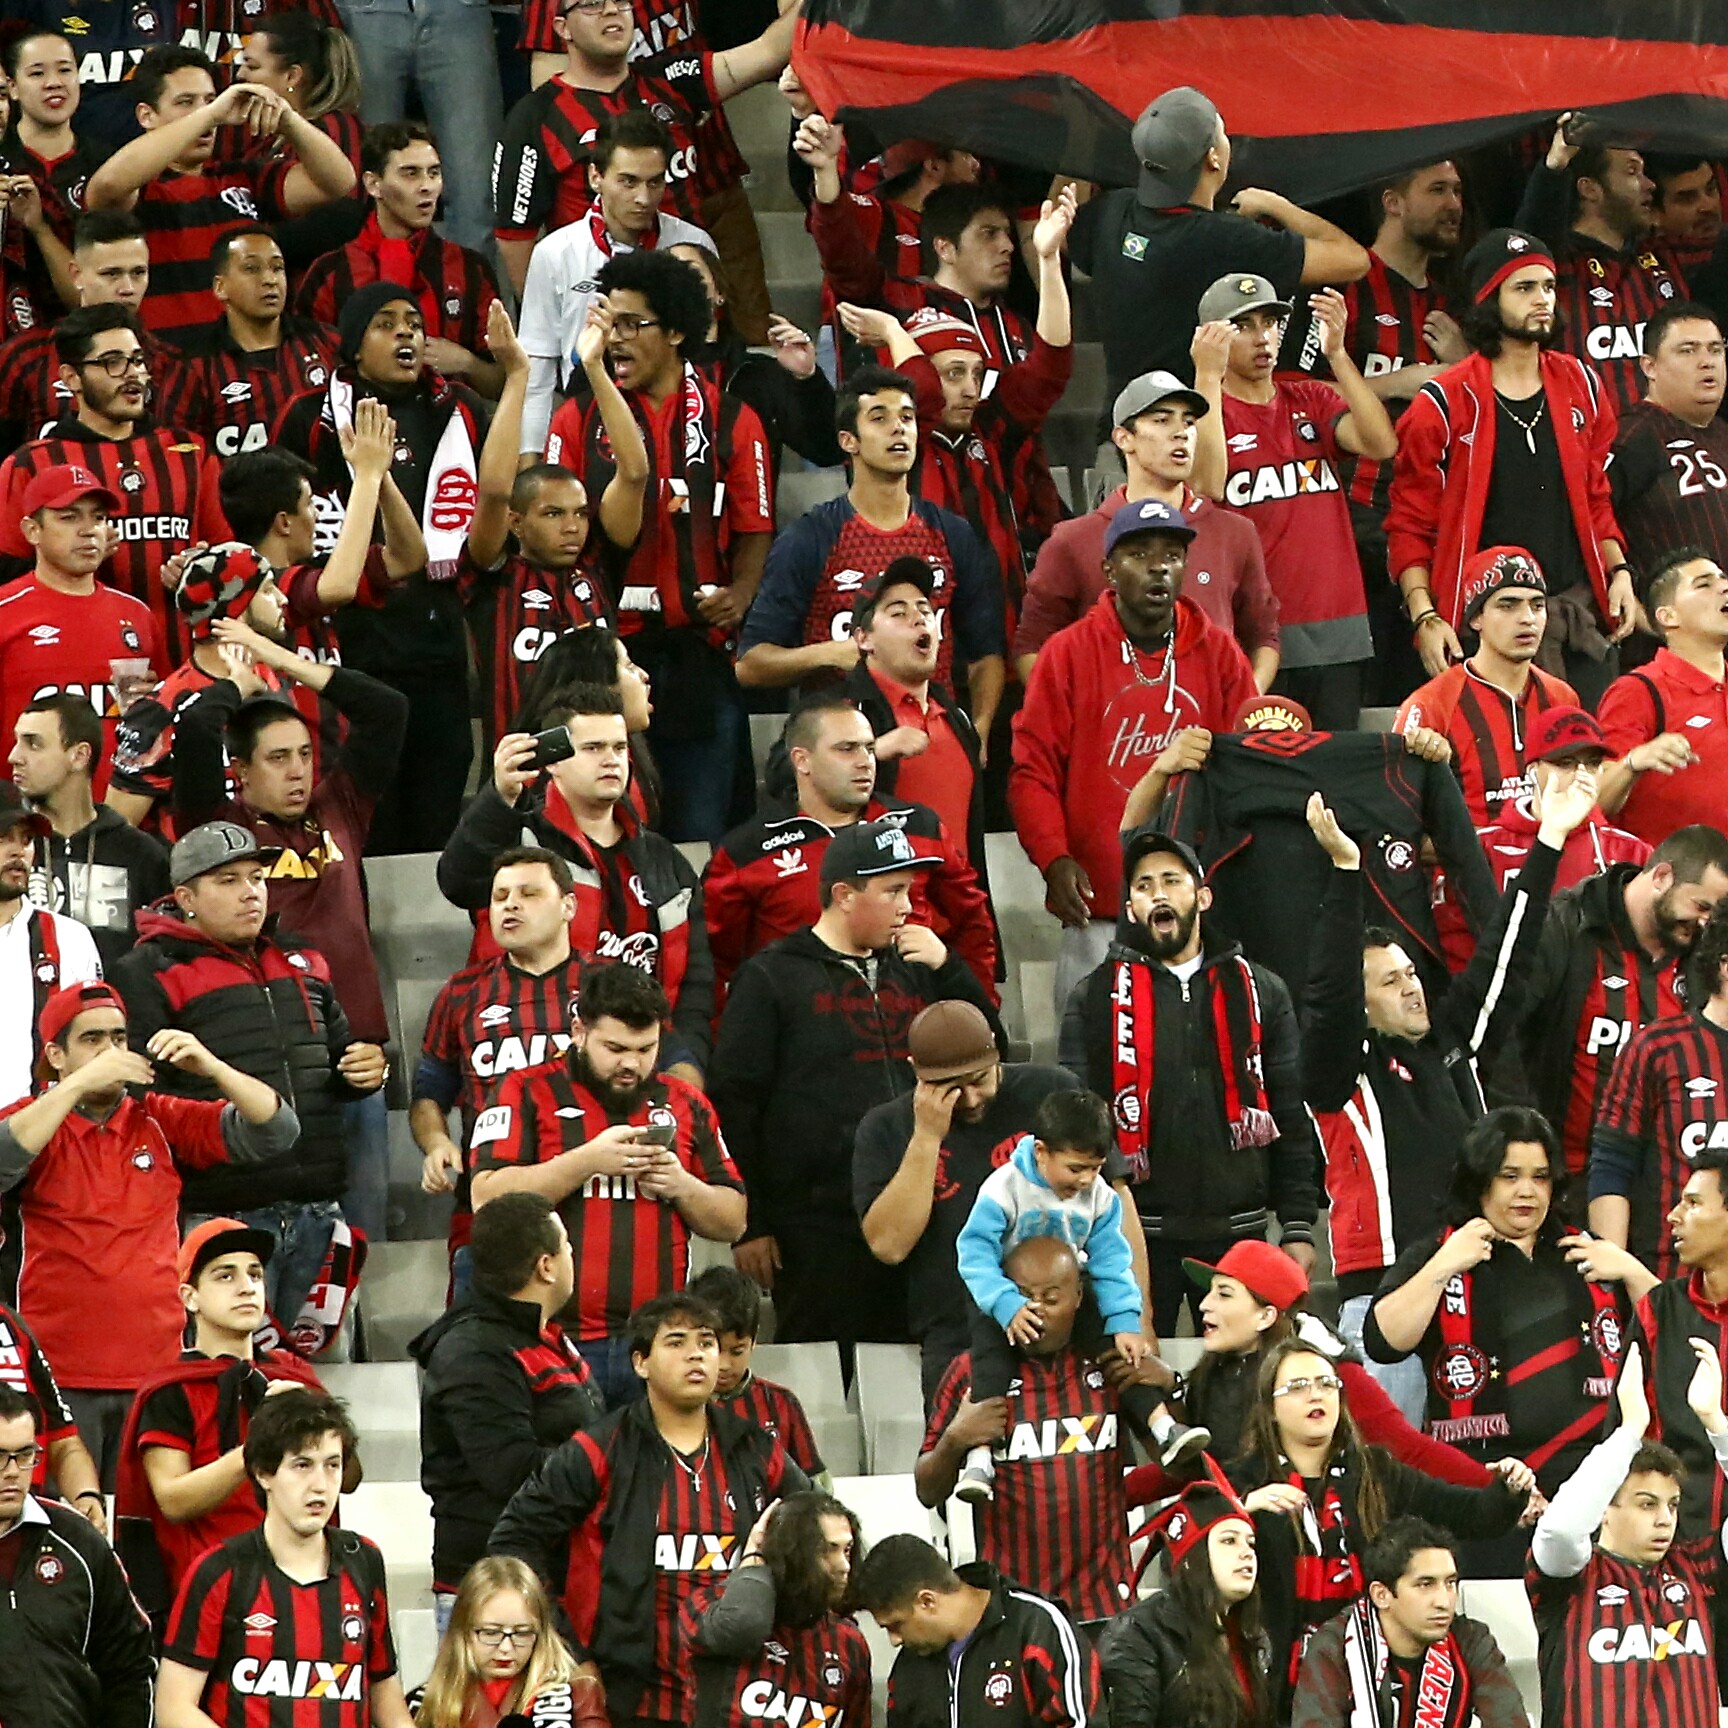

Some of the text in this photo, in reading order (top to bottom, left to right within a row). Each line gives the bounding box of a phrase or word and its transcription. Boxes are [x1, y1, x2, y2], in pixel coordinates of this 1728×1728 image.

[512, 145, 539, 227] NETSHOES
[1227, 459, 1338, 506] CAIXA
[1671, 448, 1728, 497] 25
[762, 831, 806, 851] adidas
[472, 1034, 572, 1076] CAIX
[1587, 1618, 1708, 1666] CAIXA
[231, 1658, 362, 1702] CAIXA
